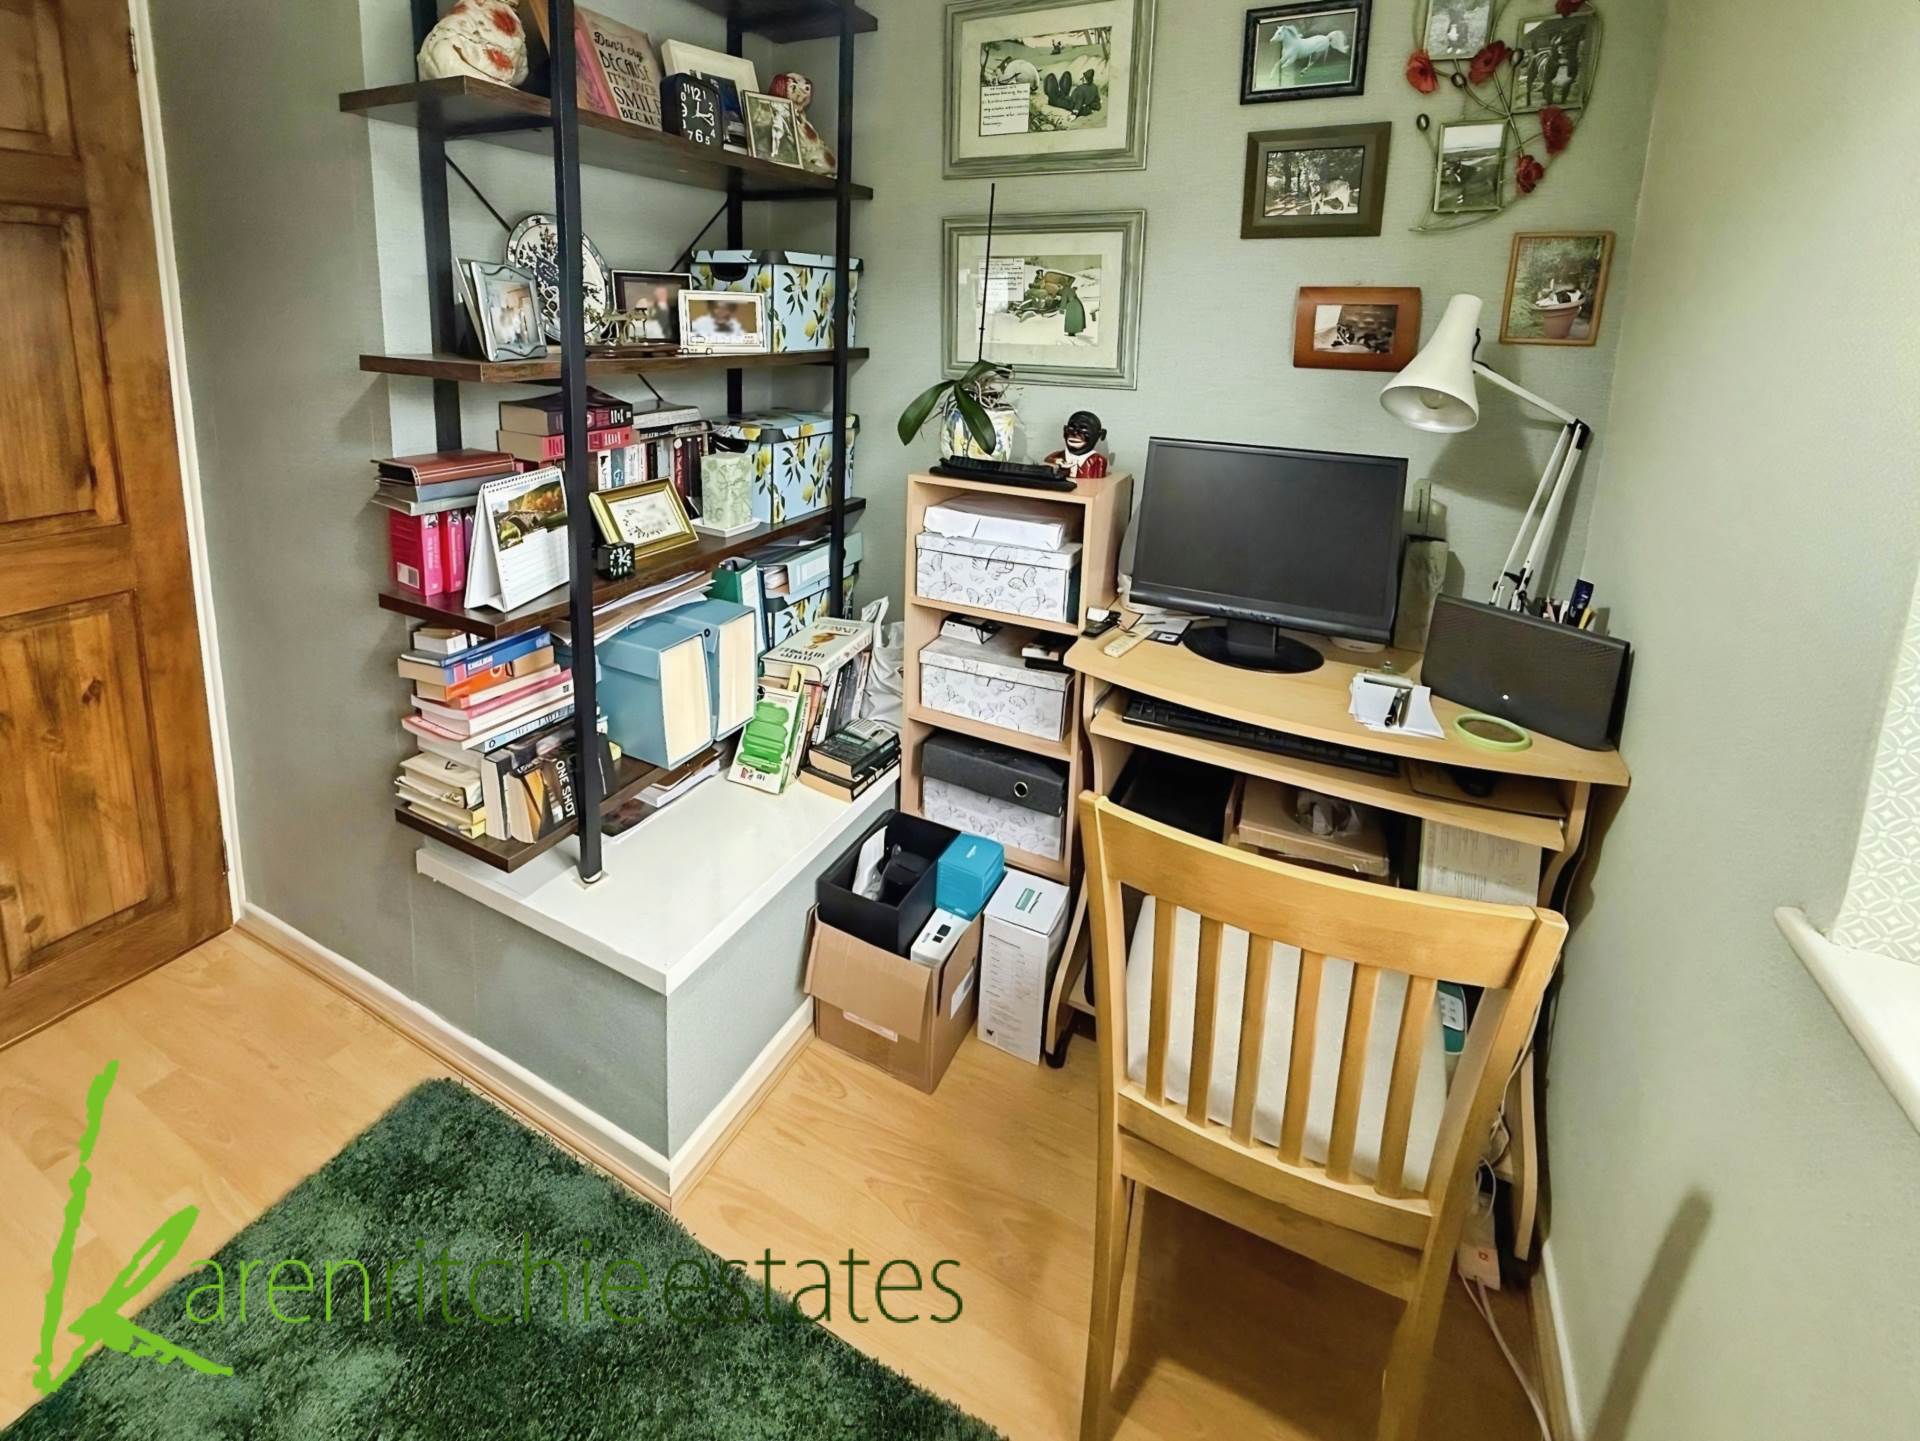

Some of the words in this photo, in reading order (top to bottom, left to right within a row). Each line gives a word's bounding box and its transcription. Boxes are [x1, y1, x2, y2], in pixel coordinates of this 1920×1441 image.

[599, 50, 653, 83] BECAUSE
[690, 86, 702, 101] 12
[695, 129, 704, 143] 6
[555, 760, 569, 786] ONE
[561, 785, 576, 818] SHOT
